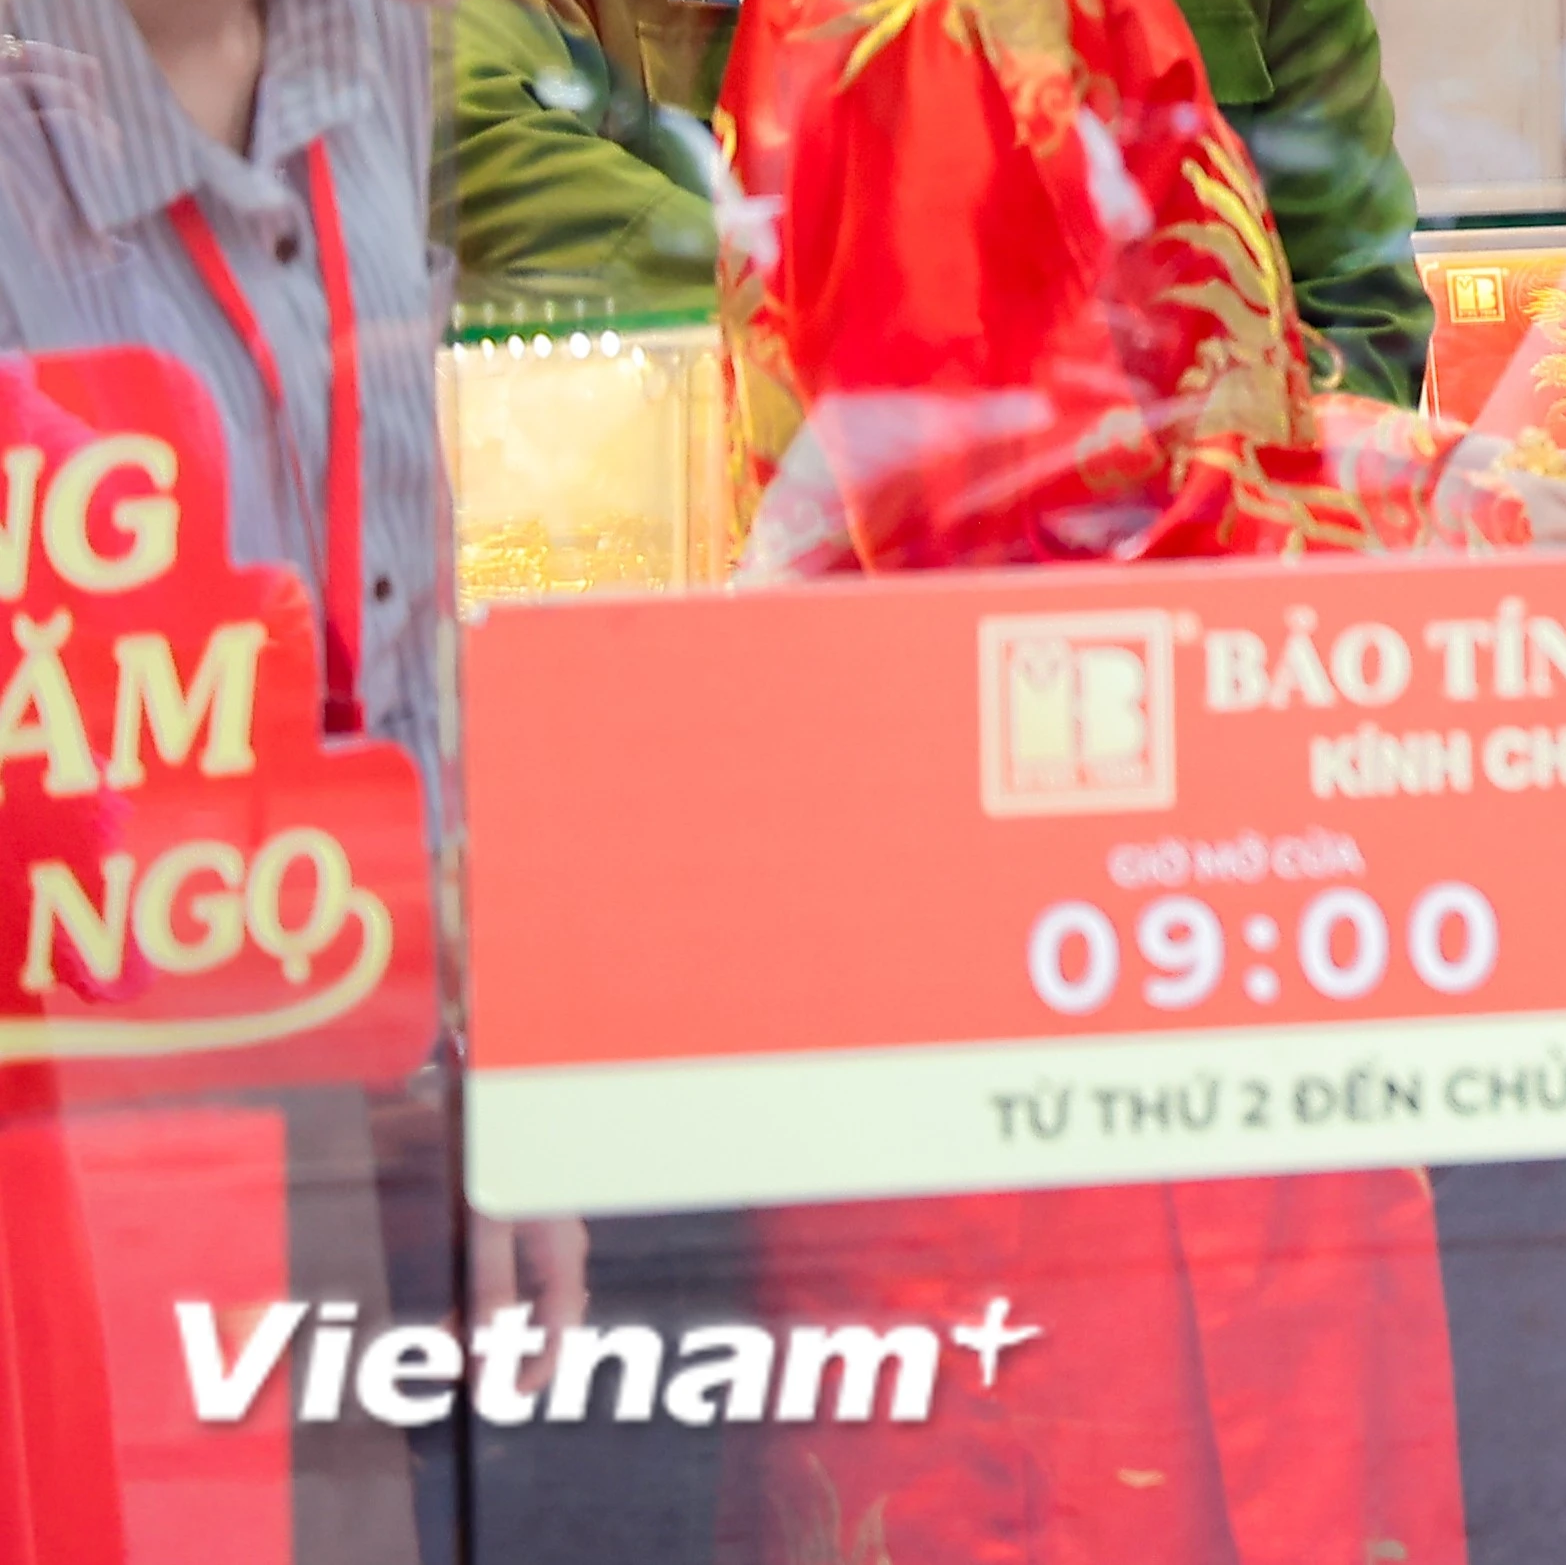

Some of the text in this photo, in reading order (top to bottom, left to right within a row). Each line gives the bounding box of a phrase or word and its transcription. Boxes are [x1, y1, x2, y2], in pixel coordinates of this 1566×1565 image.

[1202, 604, 1412, 713] BẢO
[1308, 720, 1475, 800] KÍNH
[1026, 880, 1500, 1016] 09:00
[989, 1078, 1075, 1142] TỪ
[1088, 1064, 1224, 1137] THỨ
[1239, 1079, 1274, 1130] 2
[1292, 1051, 1423, 1126] ĐẾN
